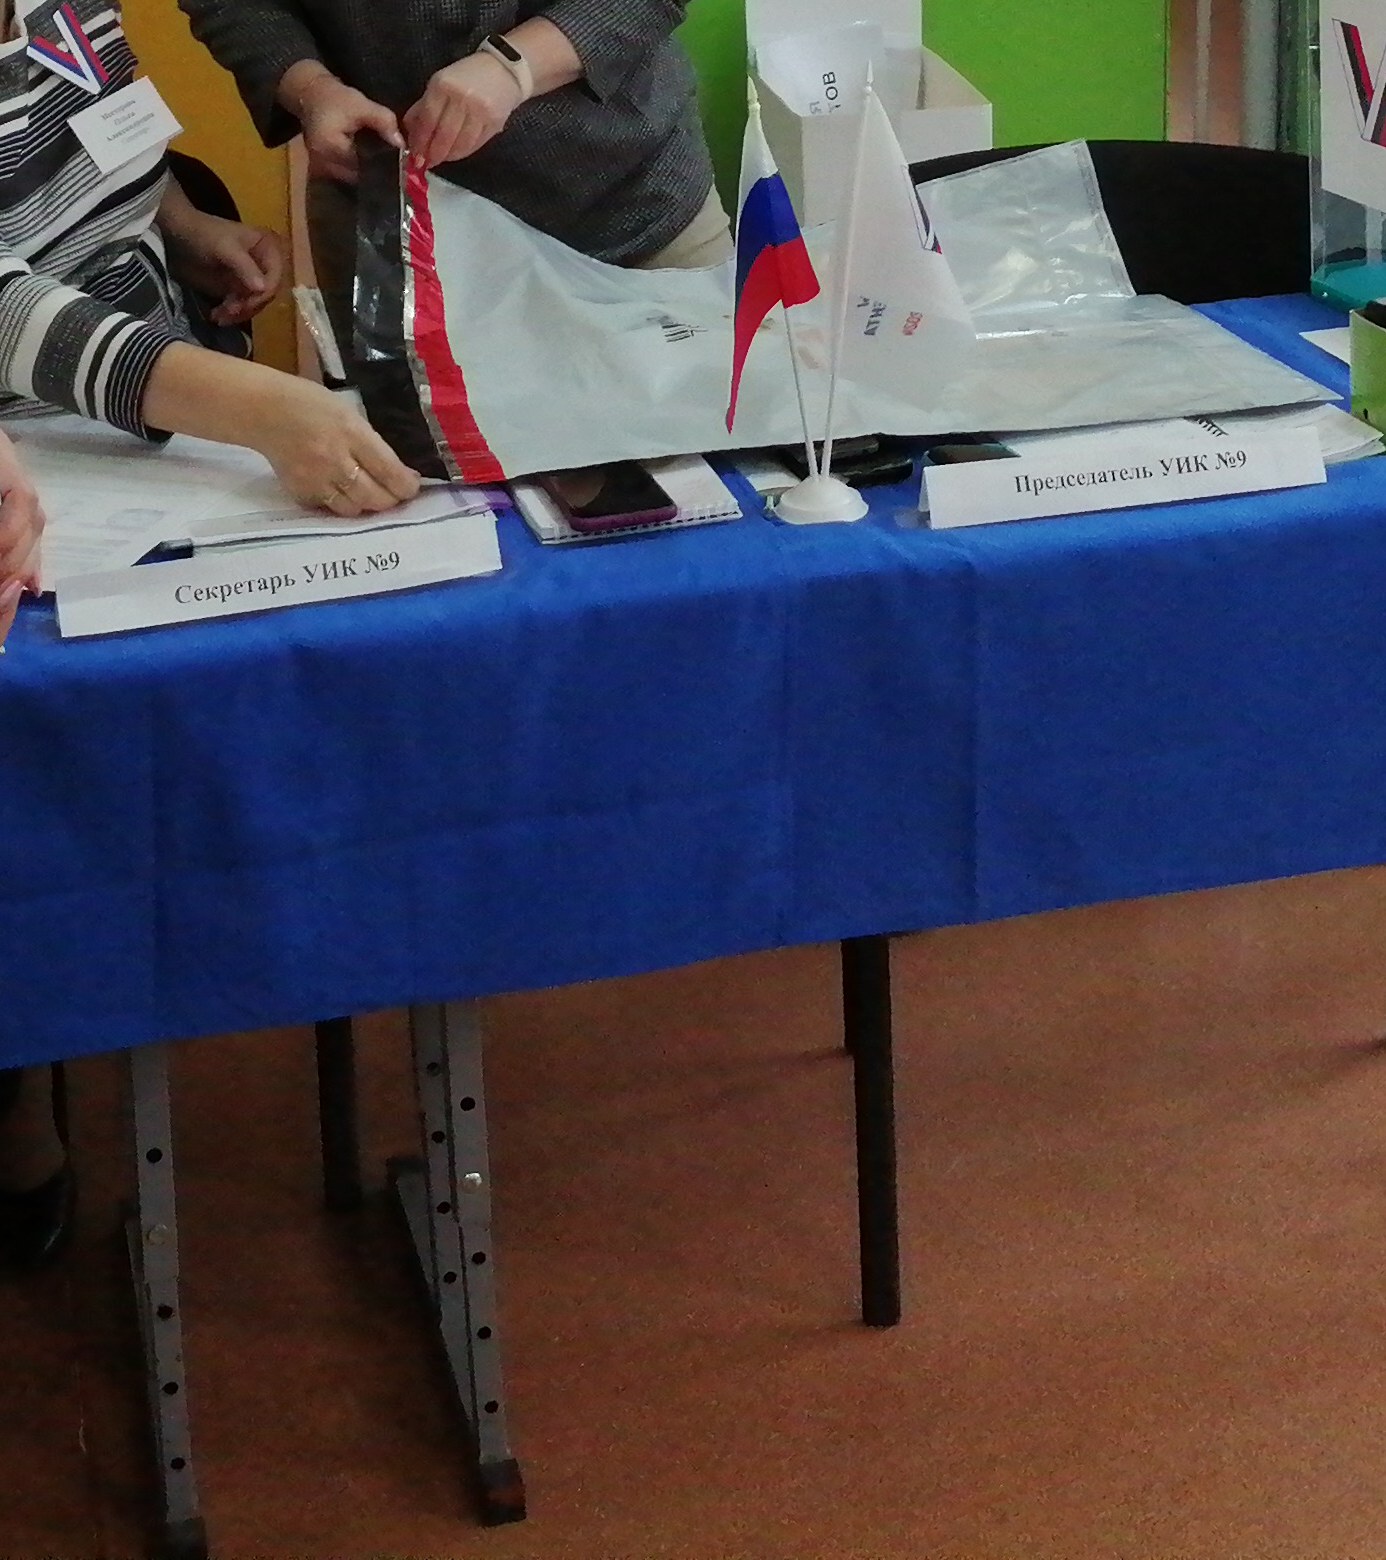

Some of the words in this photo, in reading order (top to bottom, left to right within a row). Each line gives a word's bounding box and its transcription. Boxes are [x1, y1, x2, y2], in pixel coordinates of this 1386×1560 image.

[1014, 466, 1153, 496] Председатель
[1159, 453, 1210, 476] УИК
[1215, 450, 1248, 470] №9
[174, 574, 296, 603] Секретарь
[302, 558, 358, 583] УИК
[364, 551, 401, 573] №9
